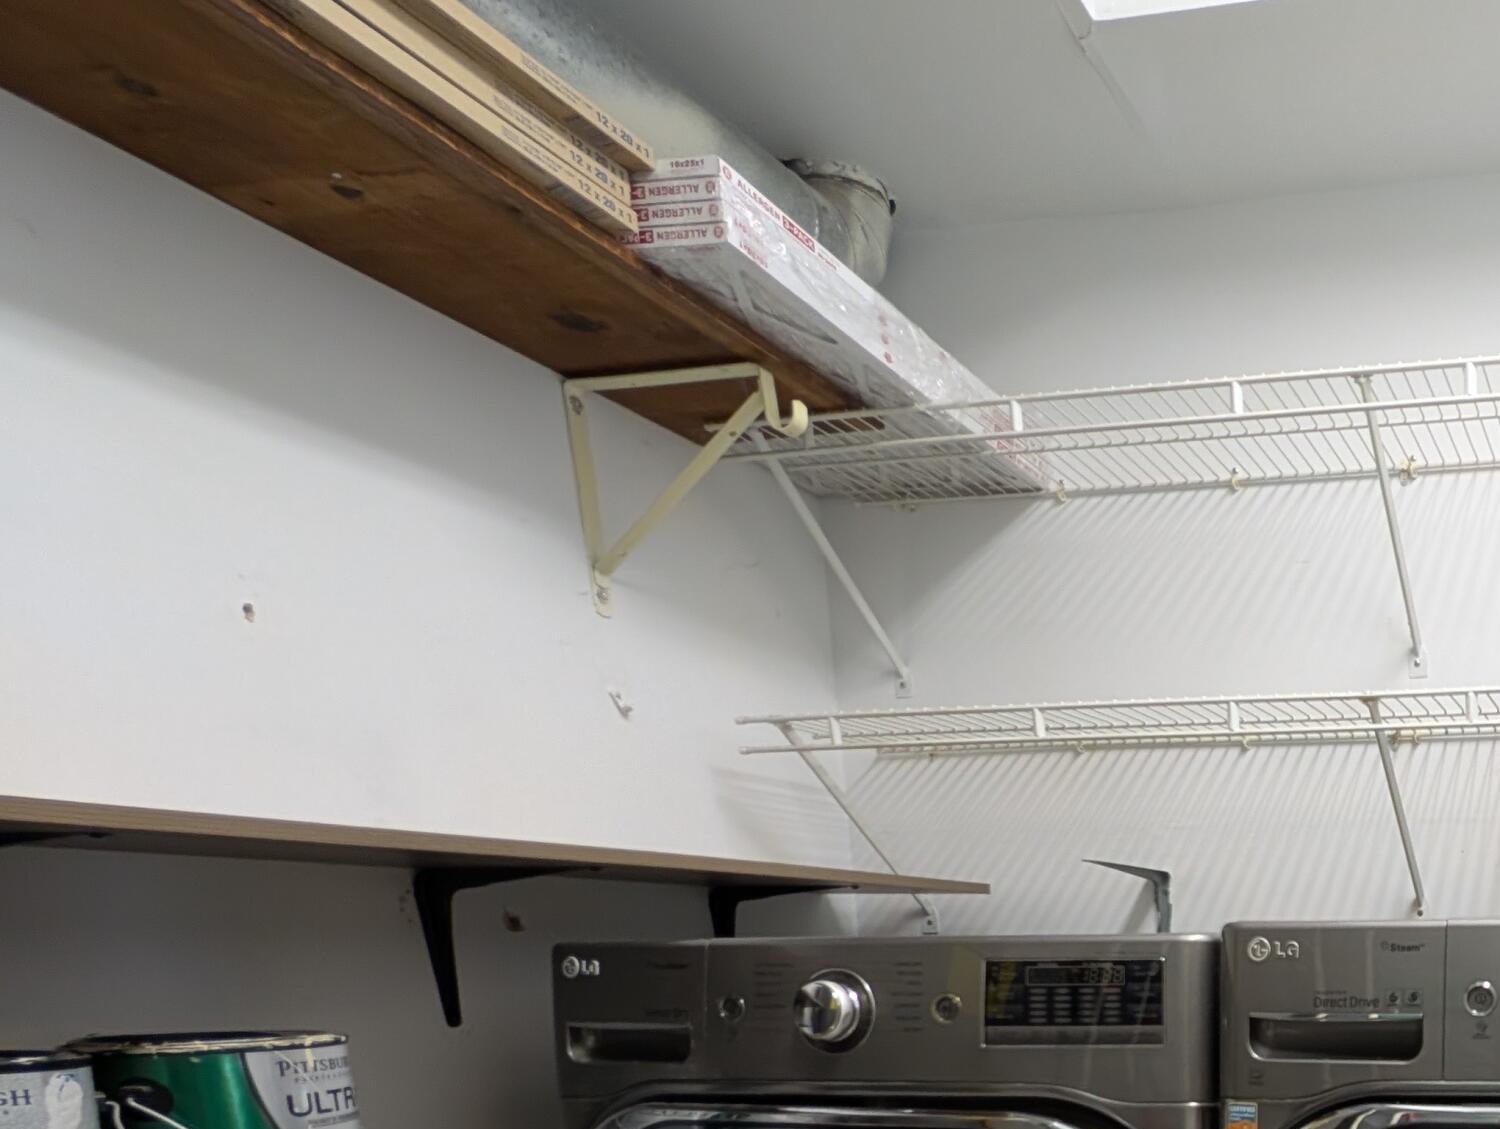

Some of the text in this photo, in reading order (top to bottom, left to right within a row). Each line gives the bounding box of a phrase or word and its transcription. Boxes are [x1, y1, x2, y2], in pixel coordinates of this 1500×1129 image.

[649, 184, 699, 196] ALLERGEN
[652, 207, 703, 219] ALLERGEN
[657, 229, 707, 240] ALLERGEN
[1274, 940, 1299, 959] LG
[581, 959, 600, 976] LG
[1313, 996, 1380, 1009] Direct Drive
